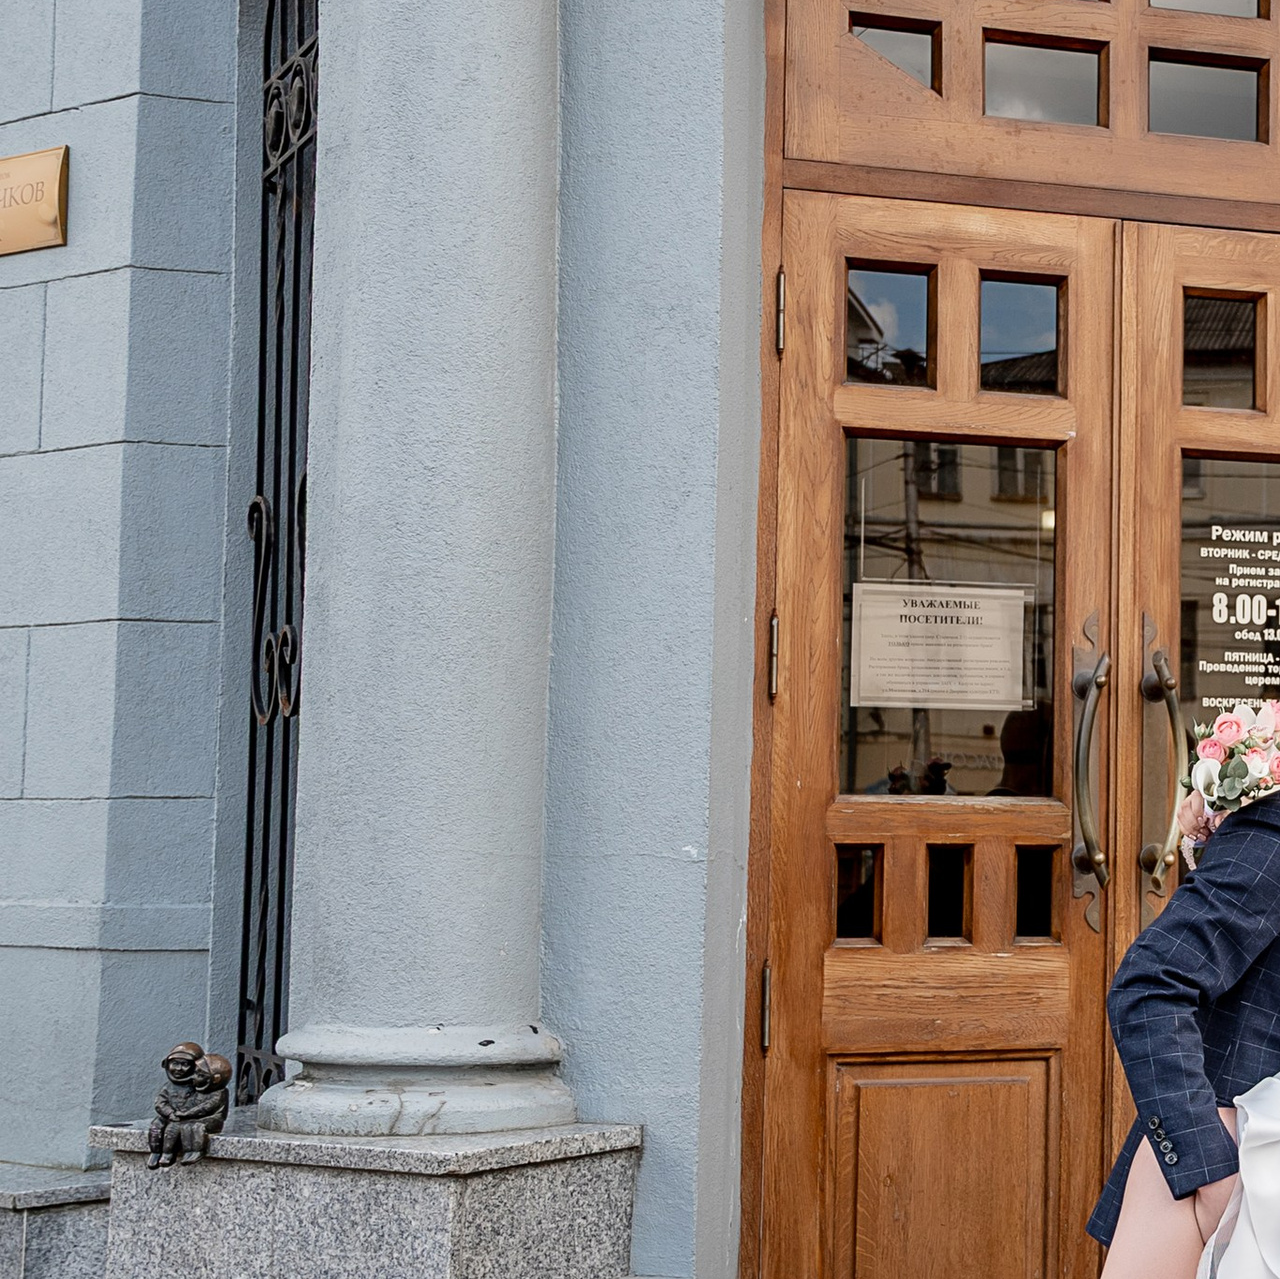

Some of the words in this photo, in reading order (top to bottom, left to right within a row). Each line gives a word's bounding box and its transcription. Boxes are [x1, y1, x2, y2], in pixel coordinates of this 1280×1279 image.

[1211, 525, 1268, 542] Режим
[1200, 547, 1250, 559] ВТОРНИК
[1229, 564, 1265, 576] Прием
[1215, 577, 1229, 586] на
[902, 598, 981, 610] УВАЖАЕМЫЕ
[899, 614, 983, 625] ПОСЕТИТЕЛИ!
[1234, 629, 1261, 641] обед
[1224, 652, 1274, 664] ПЯТНИЦА
[1199, 661, 1265, 673] Проведение
